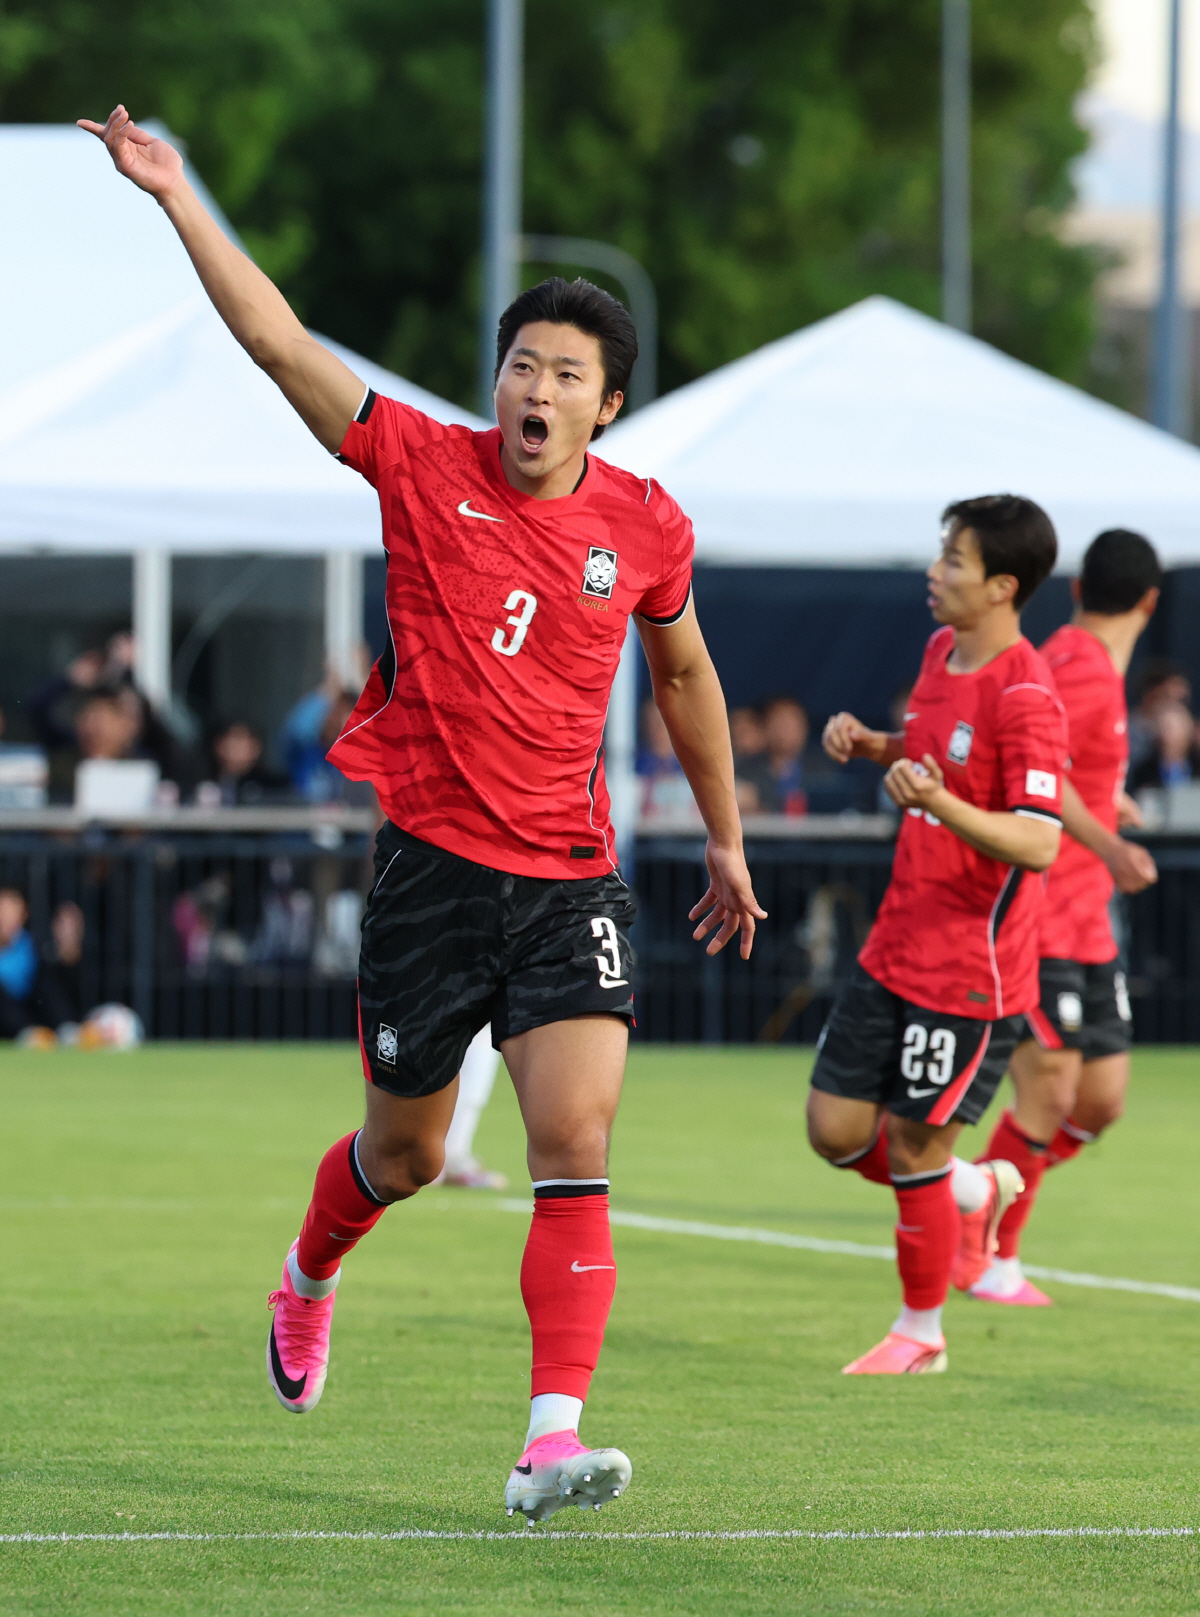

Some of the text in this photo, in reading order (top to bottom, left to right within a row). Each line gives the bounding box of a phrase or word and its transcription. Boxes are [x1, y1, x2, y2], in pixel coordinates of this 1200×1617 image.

[490, 589, 538, 657] 3
[577, 595, 609, 613] KOREA
[590, 916, 622, 979] 3
[901, 1023, 956, 1085] 23
